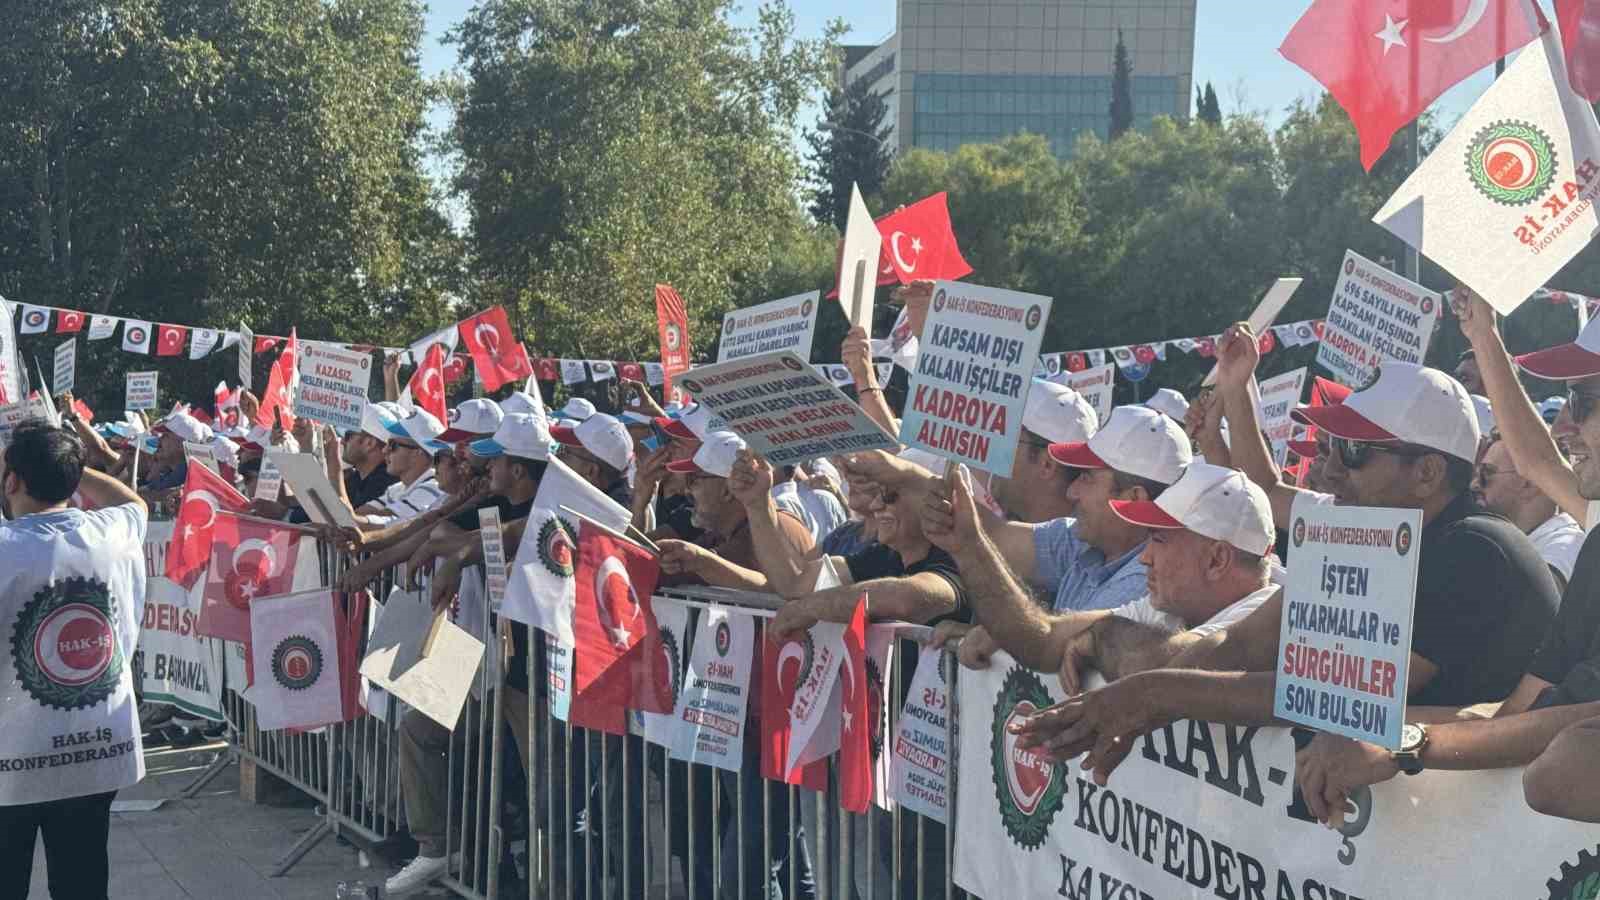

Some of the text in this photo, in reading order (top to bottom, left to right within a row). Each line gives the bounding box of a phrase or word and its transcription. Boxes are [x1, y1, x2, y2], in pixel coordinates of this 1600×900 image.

[1334, 294, 1421, 351] KAPSAMI DIŞINDA
[1361, 289, 1395, 316] SAYILI
[1396, 306, 1422, 328] KHK
[931, 323, 1024, 368] KAPSAM DIŞI
[1324, 328, 1367, 364] KADROYA
[315, 361, 353, 381] KAZASIZ
[918, 353, 1022, 398] KALAN İŞÇİLER
[913, 383, 1008, 436] KADROYA
[916, 419, 991, 463] ALINSIN
[1307, 522, 1393, 548] HAK-İŞ KONFEDERASYONU
[1321, 556, 1369, 598] İŞTEN
[58, 634, 111, 653] HAK-İŞ
[1288, 601, 1400, 646] ÇIKARMALAR ve
[1283, 637, 1398, 698] SÜRGÜNLER
[1284, 683, 1388, 737] SON BULSUN
[52, 727, 113, 749] HAK-İŞ
